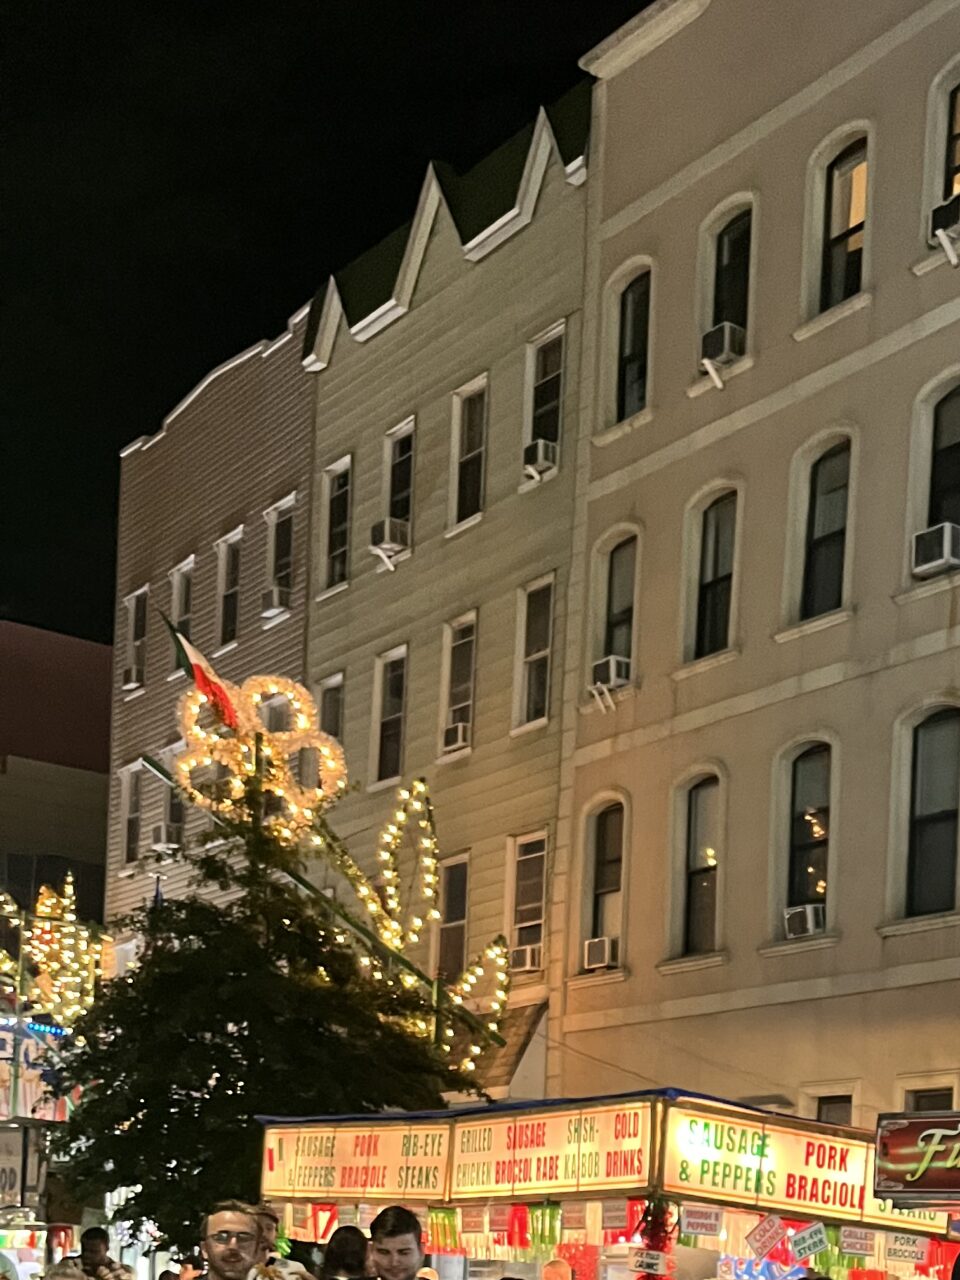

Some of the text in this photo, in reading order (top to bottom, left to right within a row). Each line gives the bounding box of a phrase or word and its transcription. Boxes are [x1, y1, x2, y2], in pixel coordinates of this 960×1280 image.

[506, 1122, 547, 1151] SAUSAGE
[614, 1112, 639, 1140] COLD
[689, 1119, 771, 1158] SAUSAGE
[295, 1135, 336, 1157] SAUSAGE
[354, 1134, 380, 1157] PORK
[401, 1134, 443, 1157] RIB-EYE
[461, 1128, 492, 1154] GRILLED
[605, 1148, 643, 1178] DRINKS
[804, 1141, 850, 1172] PORK
[397, 1166, 439, 1189] STEAKS
[456, 1162, 492, 1187] CHICKEN
[679, 1159, 776, 1196] & PEPPERS
[753, 1218, 776, 1242] COLD
[894, 1235, 918, 1248] PORK
